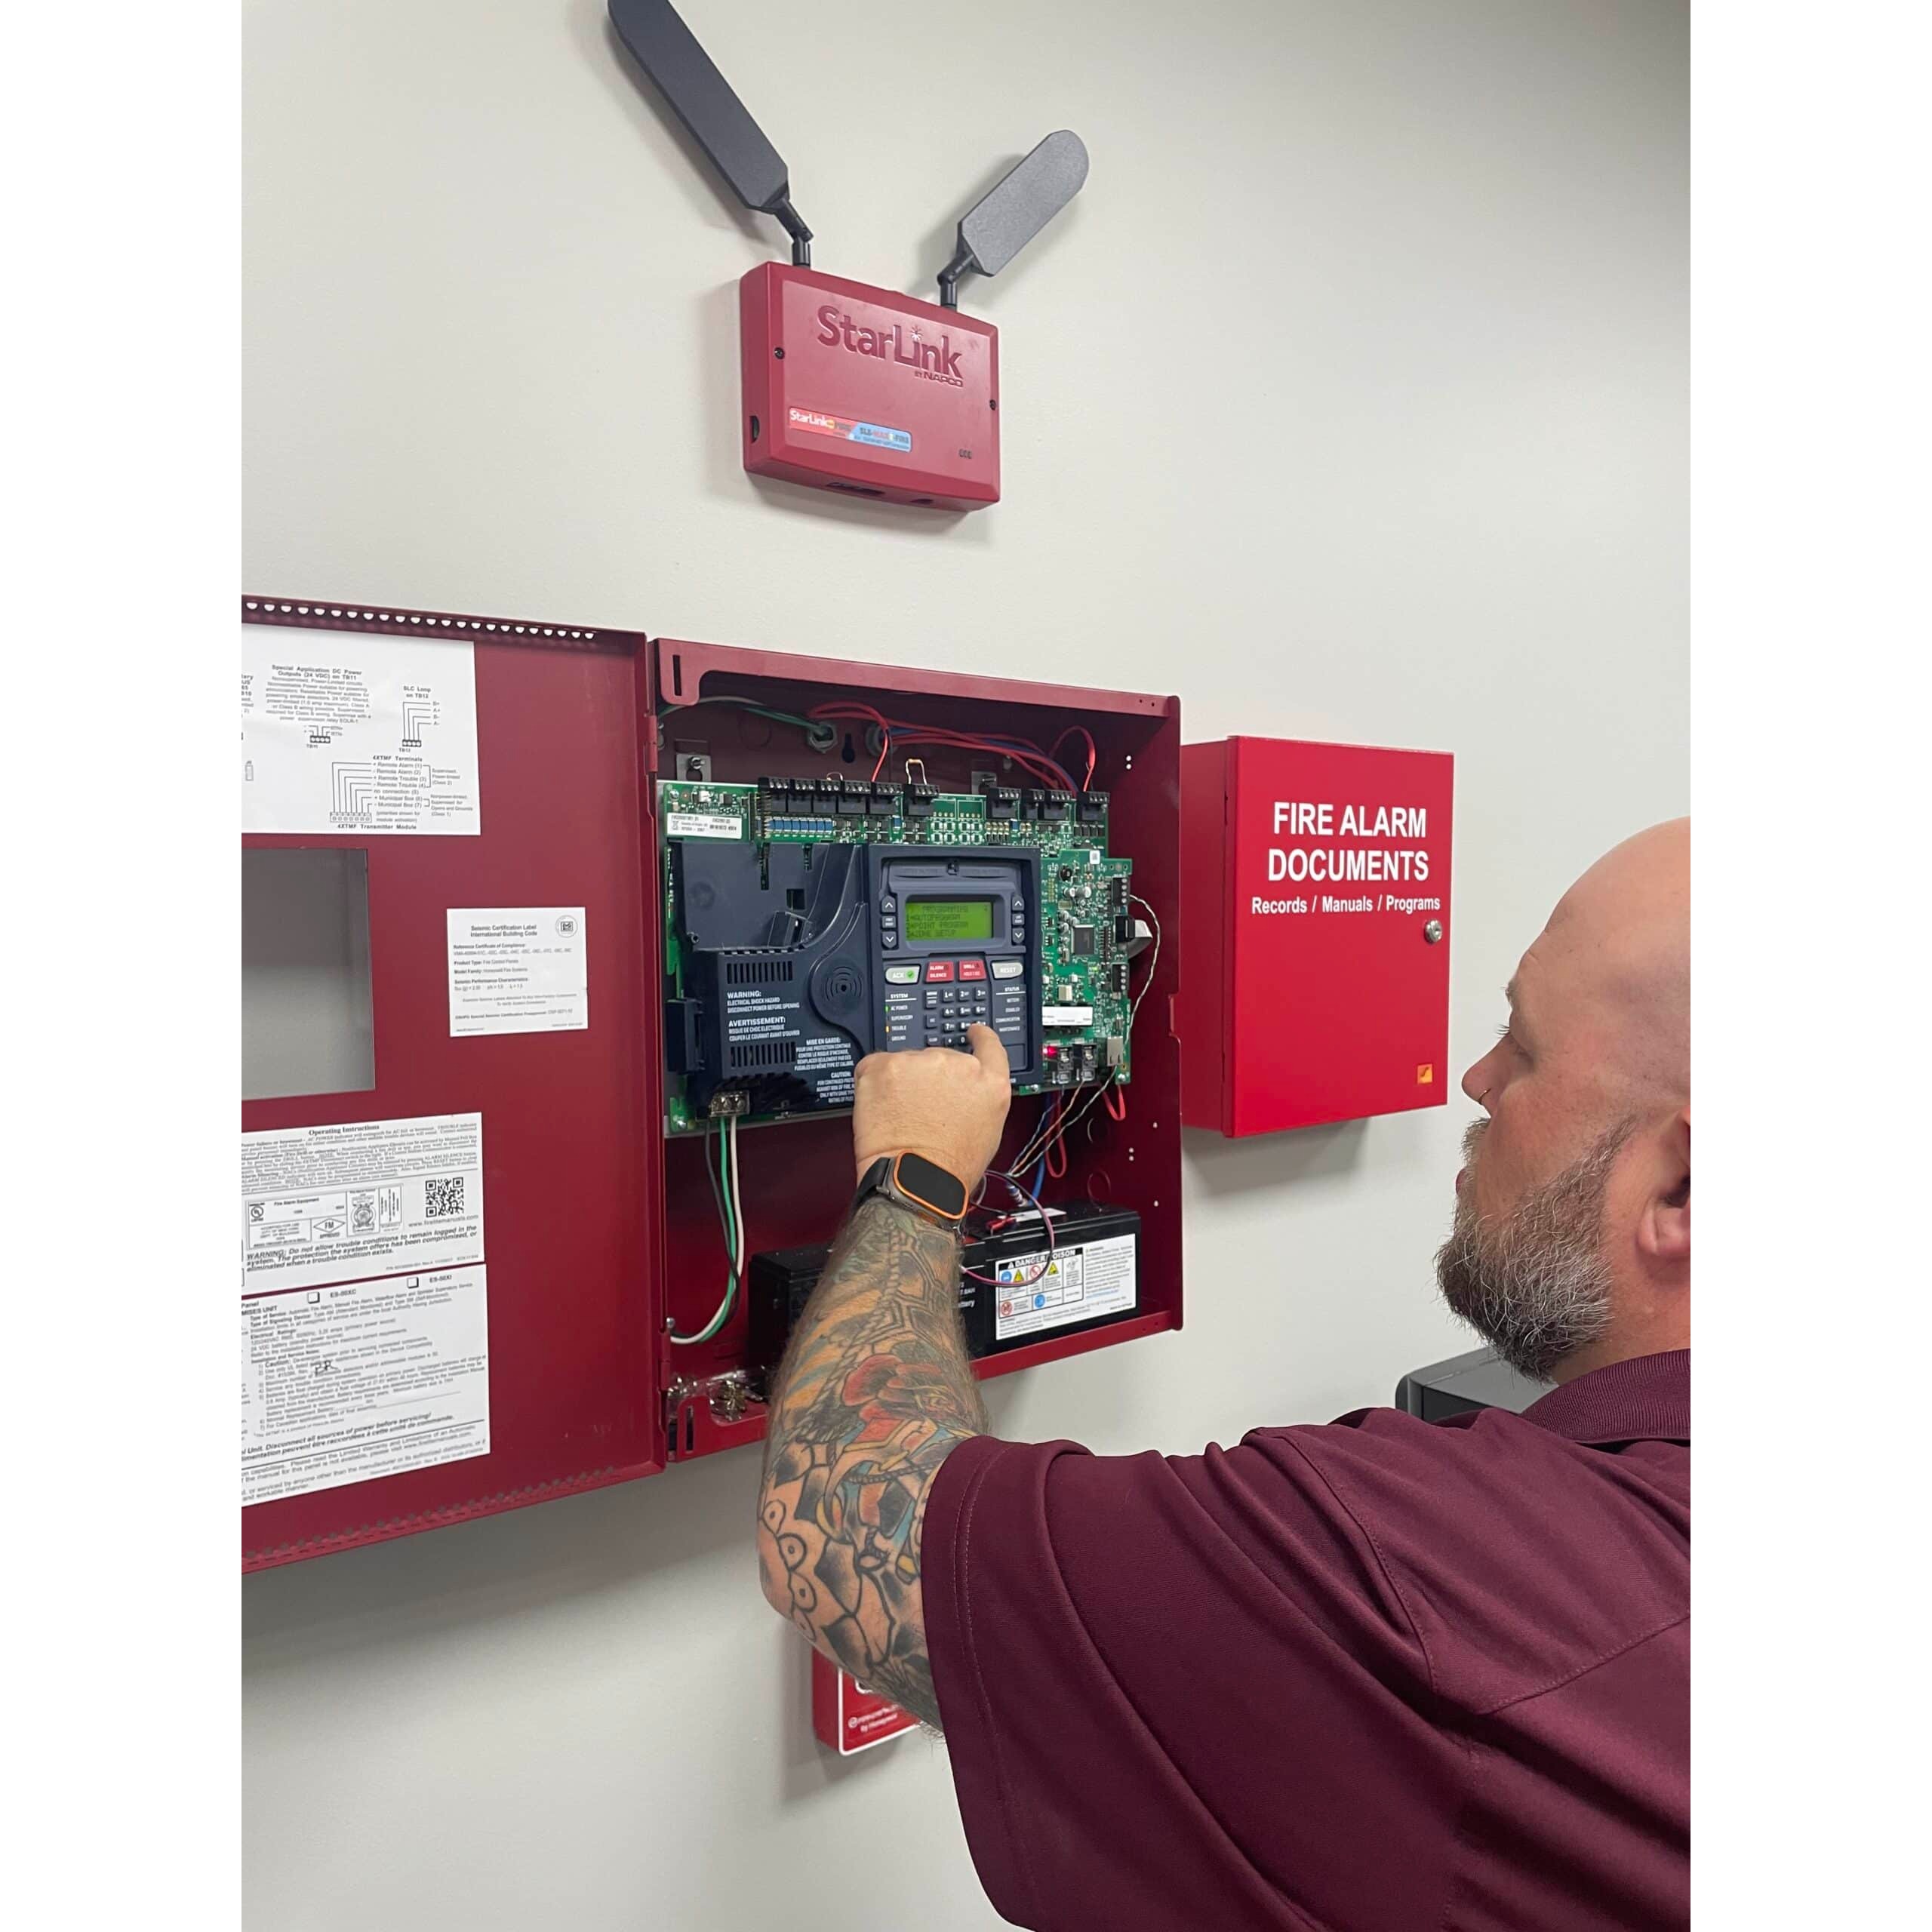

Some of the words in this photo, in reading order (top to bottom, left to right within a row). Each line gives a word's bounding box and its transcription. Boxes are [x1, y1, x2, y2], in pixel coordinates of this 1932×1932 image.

[817, 305, 964, 379] StarLink
[924, 371, 963, 388] NAPCO
[789, 410, 827, 428] StarLink
[1274, 801, 1334, 836] FIRE
[1340, 804, 1427, 838] ALARM
[1268, 848, 1429, 881] DOCUMENTS
[1251, 896, 1307, 914] Records
[1312, 895, 1317, 912] /
[1322, 896, 1374, 912] Manuals
[1377, 894, 1383, 911] /
[1386, 895, 1441, 915] Programs
[727, 990, 761, 998] WARNING:
[728, 1016, 786, 1027] AVERTISSEMENT:
[309, 1128, 341, 1137] Operating
[343, 1124, 380, 1133] Instructions
[247, 1258, 275, 1269] system.
[292, 1251, 329, 1262] protection
[343, 1244, 368, 1255] system
[369, 1242, 389, 1251] offers
[405, 1238, 421, 1246] been
[422, 1232, 469, 1244] compromised,
[248, 1249, 287, 1260] WARNING:
[315, 1244, 334, 1252] allow
[336, 1240, 361, 1248] trouble
[362, 1235, 398, 1245] conditions
[434, 1227, 457, 1238] logged
[247, 1262, 285, 1272] eliminated
[312, 1255, 337, 1263] trouble
[338, 1250, 371, 1260] condition
[1015, 1250, 1076, 1266] DANGER/OISON
[266, 1437, 306, 1451] Disconnect
[317, 1430, 344, 1441] sources
[354, 1424, 375, 1434] power
[377, 1419, 397, 1428] before
